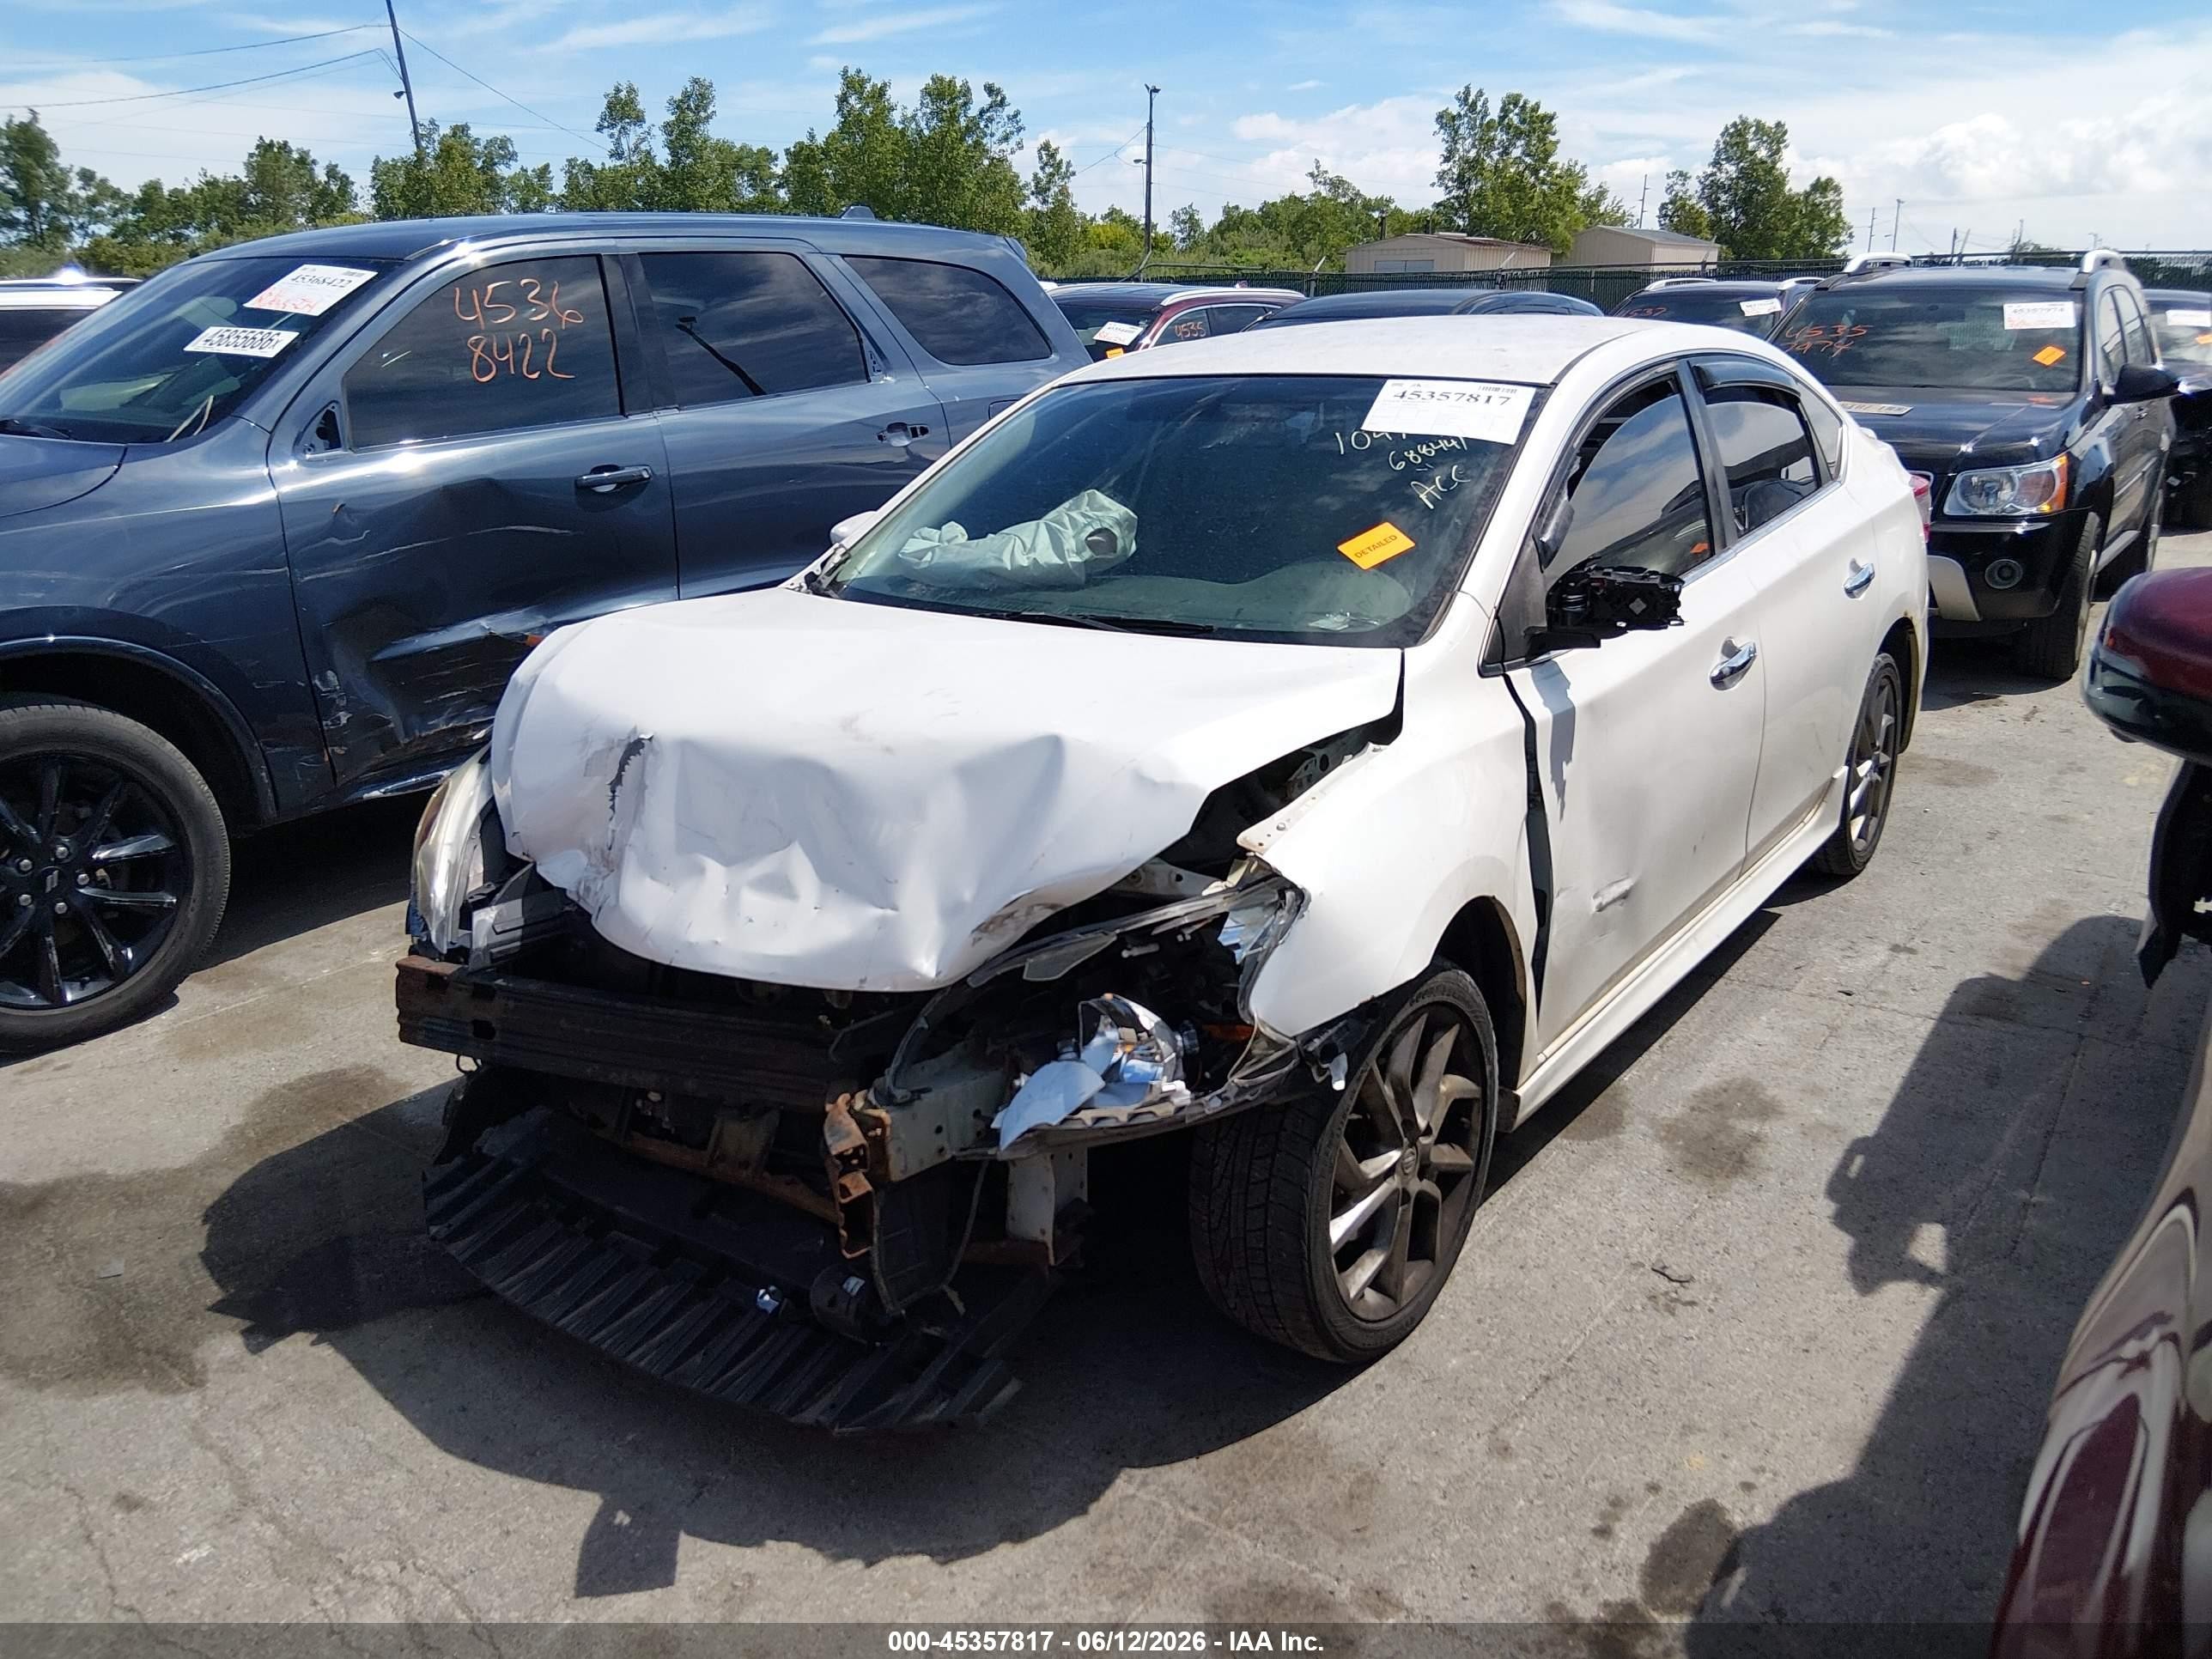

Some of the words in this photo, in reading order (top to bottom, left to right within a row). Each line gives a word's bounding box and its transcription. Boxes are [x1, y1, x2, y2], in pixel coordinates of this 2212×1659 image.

[290, 273, 353, 289] 45368422
[454, 278, 584, 330] 4536
[1175, 321, 1206, 340] 4535
[467, 328, 576, 382] 8422
[1393, 390, 1512, 406] 45357817
[1353, 533, 1399, 559] DETAILED
